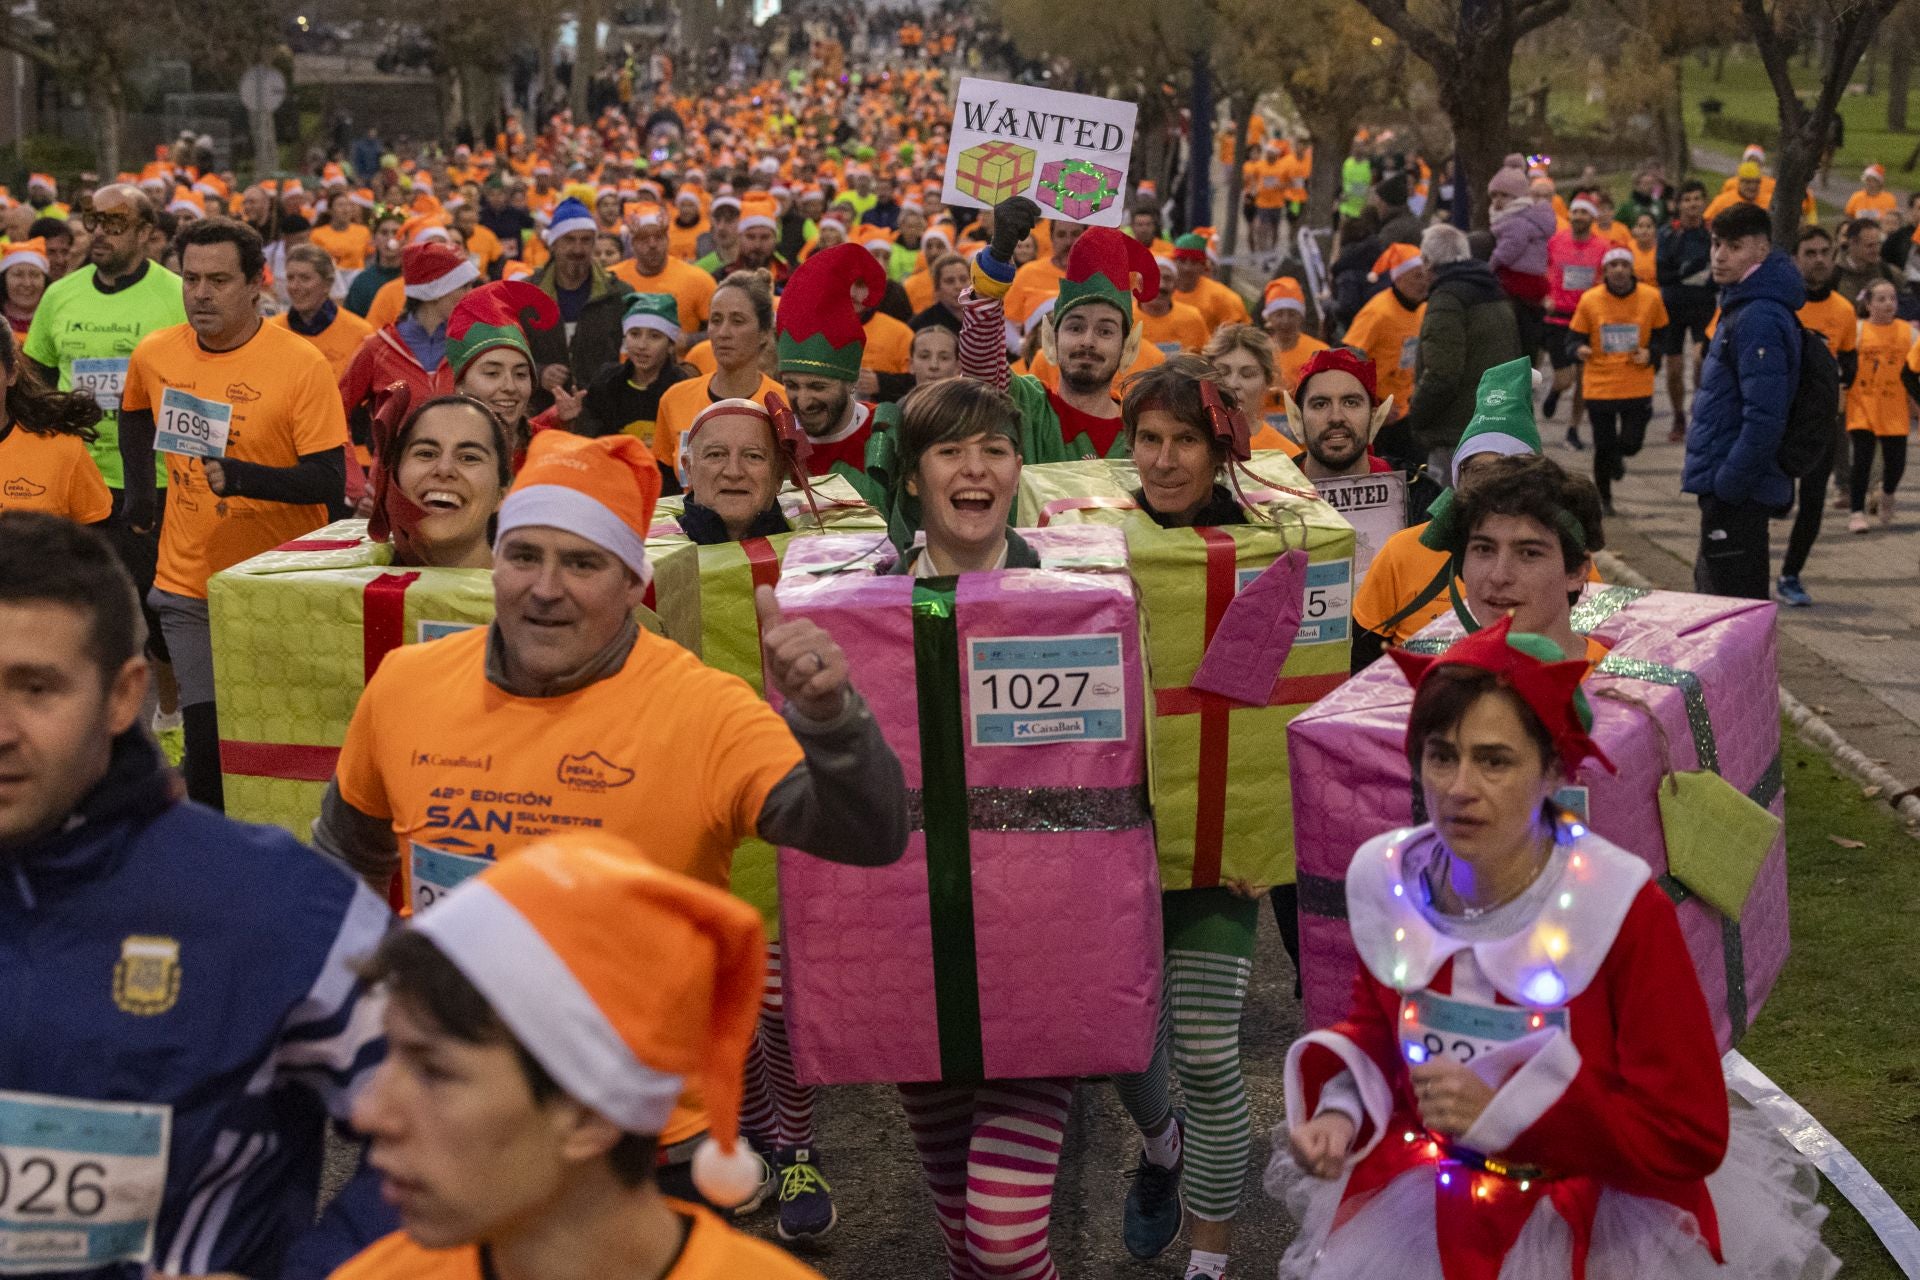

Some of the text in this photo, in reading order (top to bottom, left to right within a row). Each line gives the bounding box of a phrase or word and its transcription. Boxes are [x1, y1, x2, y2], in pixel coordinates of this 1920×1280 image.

[963, 99, 1125, 152] WANTED
[76, 374, 119, 391] 1975
[165, 409, 210, 441] 1699
[982, 672, 1090, 709] 1027
[1031, 720, 1082, 734] CaixaBank
[471, 789, 552, 807] EDICIÓN
[426, 805, 603, 834] SAN SILVESTRE
